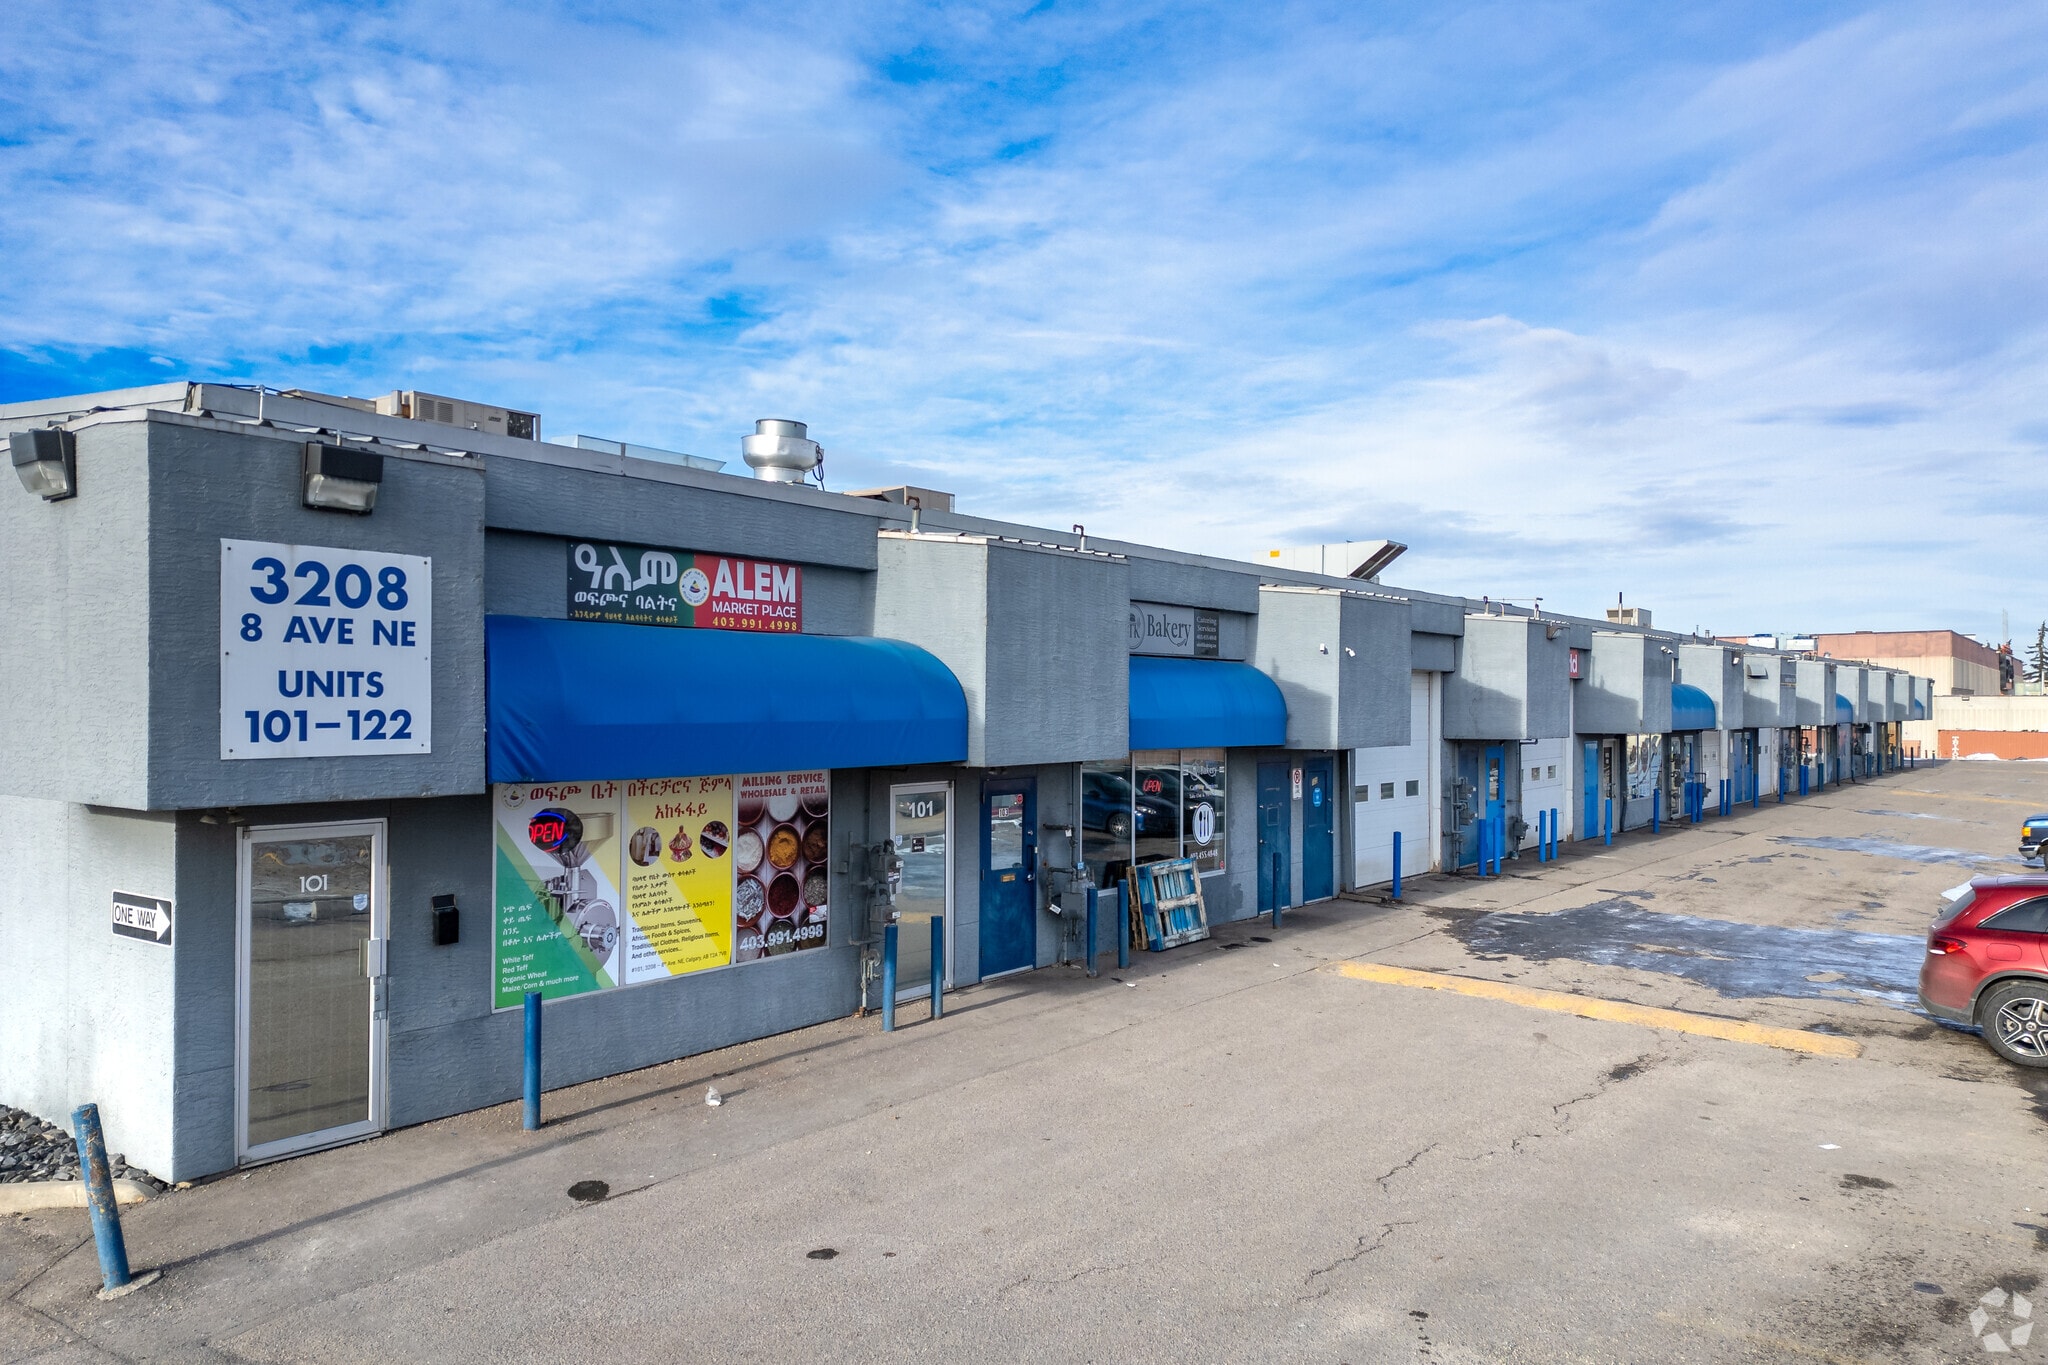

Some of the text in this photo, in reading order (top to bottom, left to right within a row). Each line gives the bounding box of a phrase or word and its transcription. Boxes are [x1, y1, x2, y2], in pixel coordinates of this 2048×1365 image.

[250, 557, 408, 611] 3208
[712, 559, 796, 603] ALEM
[712, 601, 797, 618] MARKET PLACE
[240, 613, 416, 647] 8 AVE NE
[712, 616, 797, 631] 403.991.4998
[1147, 613, 1192, 647] Bakery
[1569, 653, 1578, 673] ld
[278, 670, 384, 698] UNITS
[742, 773, 825, 787] MILLING SERVICE,
[1142, 780, 1162, 792] OPEN
[592, 781, 617, 799] ቤት
[740, 788, 787, 798] WHOLESALE
[800, 786, 826, 794] RETAIL
[908, 800, 934, 818] 101
[300, 874, 328, 892] 101
[115, 905, 156, 928] ONE WAY
[632, 924, 660, 933] Traditional
[632, 934, 650, 942] African
[632, 942, 659, 950] Traditional
[681, 934, 704, 942] Religious
[740, 924, 824, 951] 403.991.4998
[502, 954, 534, 964] White Teff
[502, 964, 528, 974] Red Teff
[502, 970, 548, 984] Organic Wheat
[502, 982, 538, 993] Maize/Corn
[546, 978, 562, 986] much
